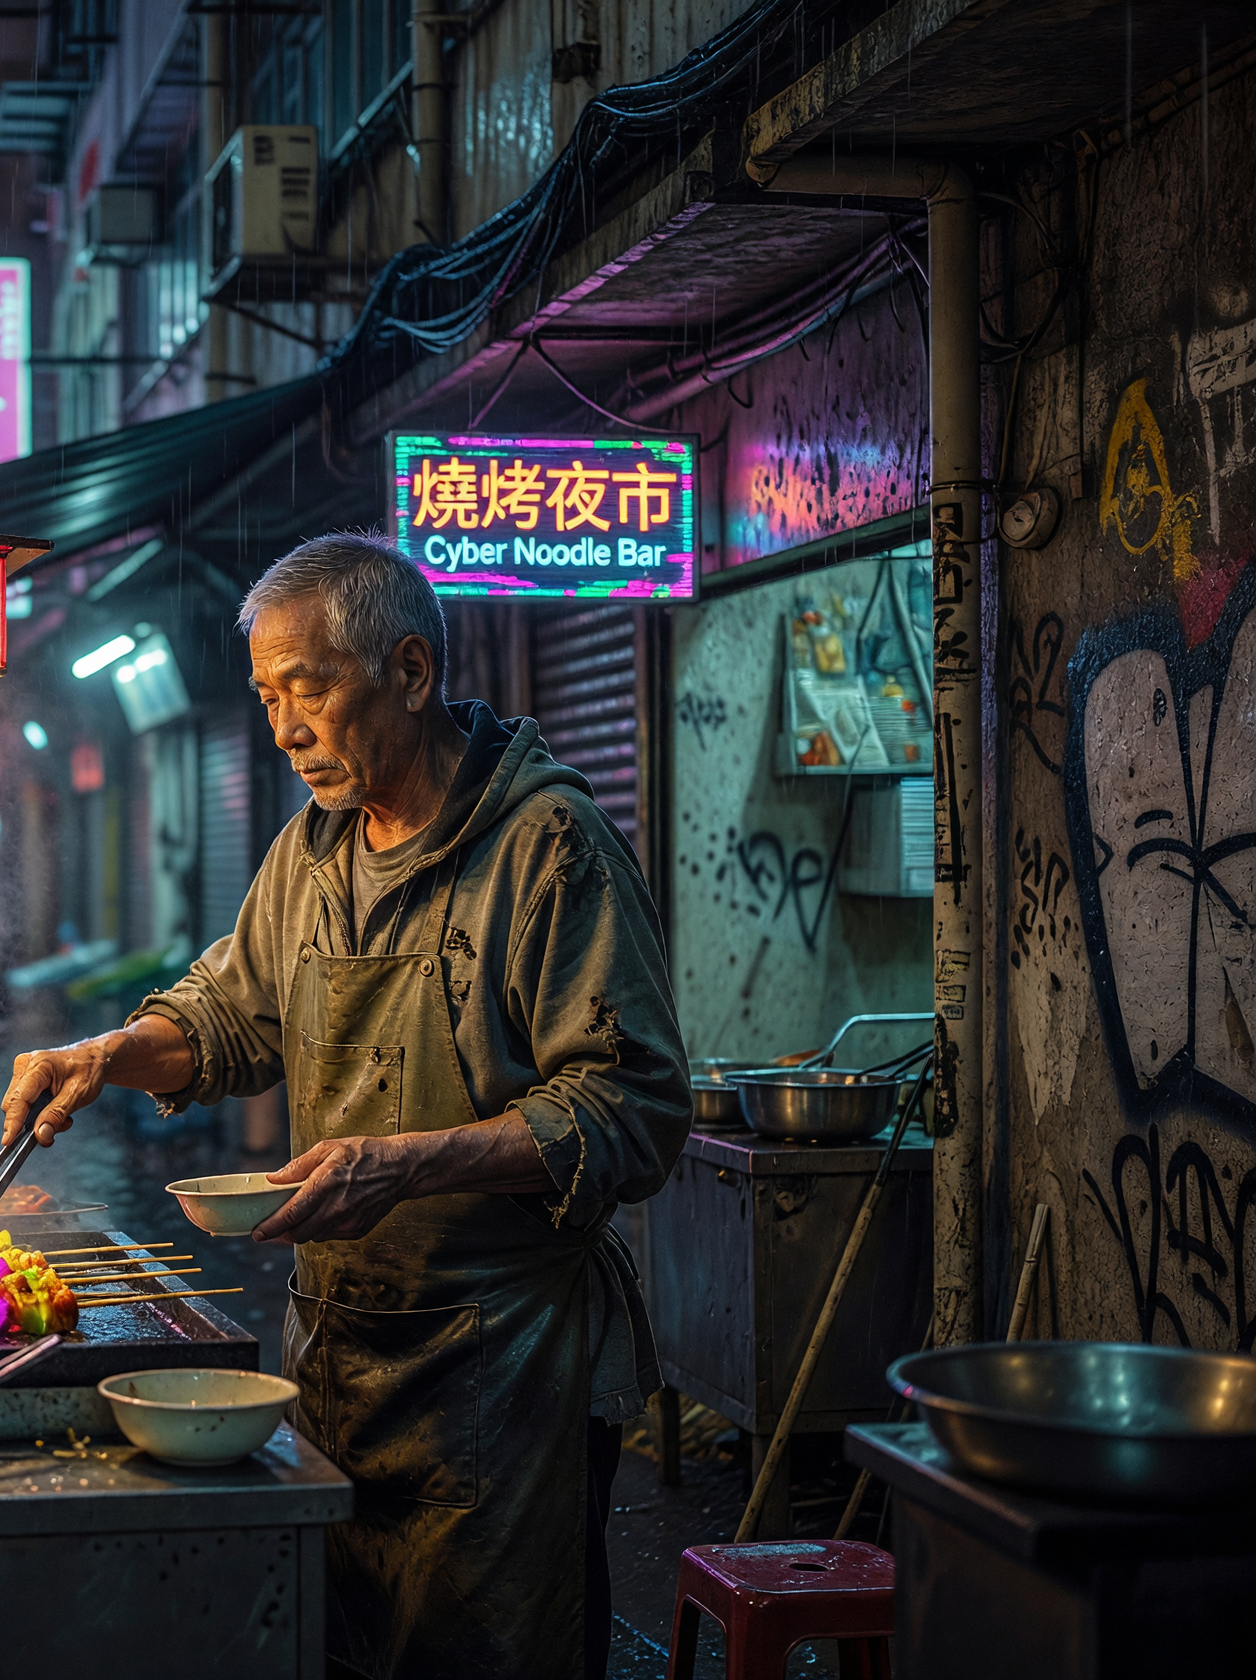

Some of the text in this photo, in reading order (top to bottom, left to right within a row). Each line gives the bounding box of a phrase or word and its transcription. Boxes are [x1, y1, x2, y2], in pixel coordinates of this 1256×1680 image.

[412, 456, 677, 532] 燒烤夜市
[424, 535, 667, 573] Cyber Noodle Bar
